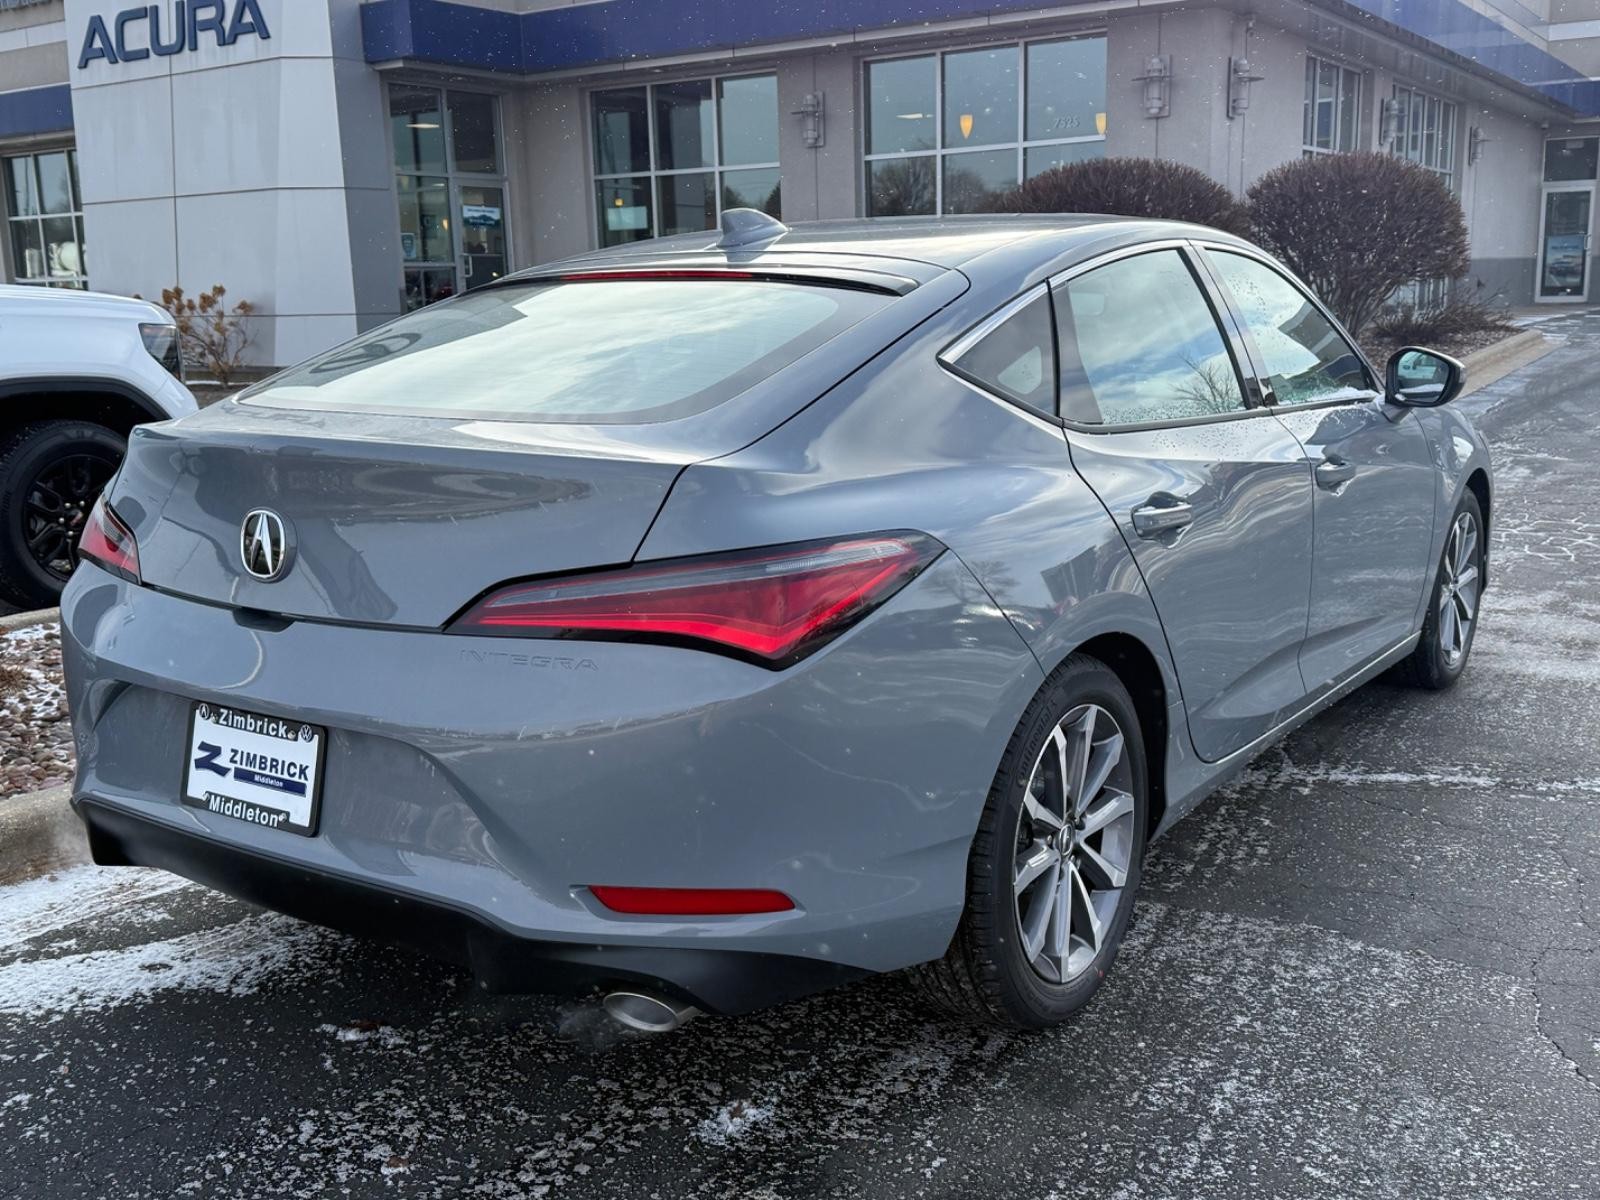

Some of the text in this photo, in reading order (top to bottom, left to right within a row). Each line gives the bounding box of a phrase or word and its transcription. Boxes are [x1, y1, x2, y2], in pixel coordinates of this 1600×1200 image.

[77, 0, 271, 69] ACURA
[460, 649, 600, 671] INTEGRA
[219, 708, 288, 738] Zimbrick
[229, 748, 310, 781] ZIMBRICK
[209, 793, 279, 828] Middleton
